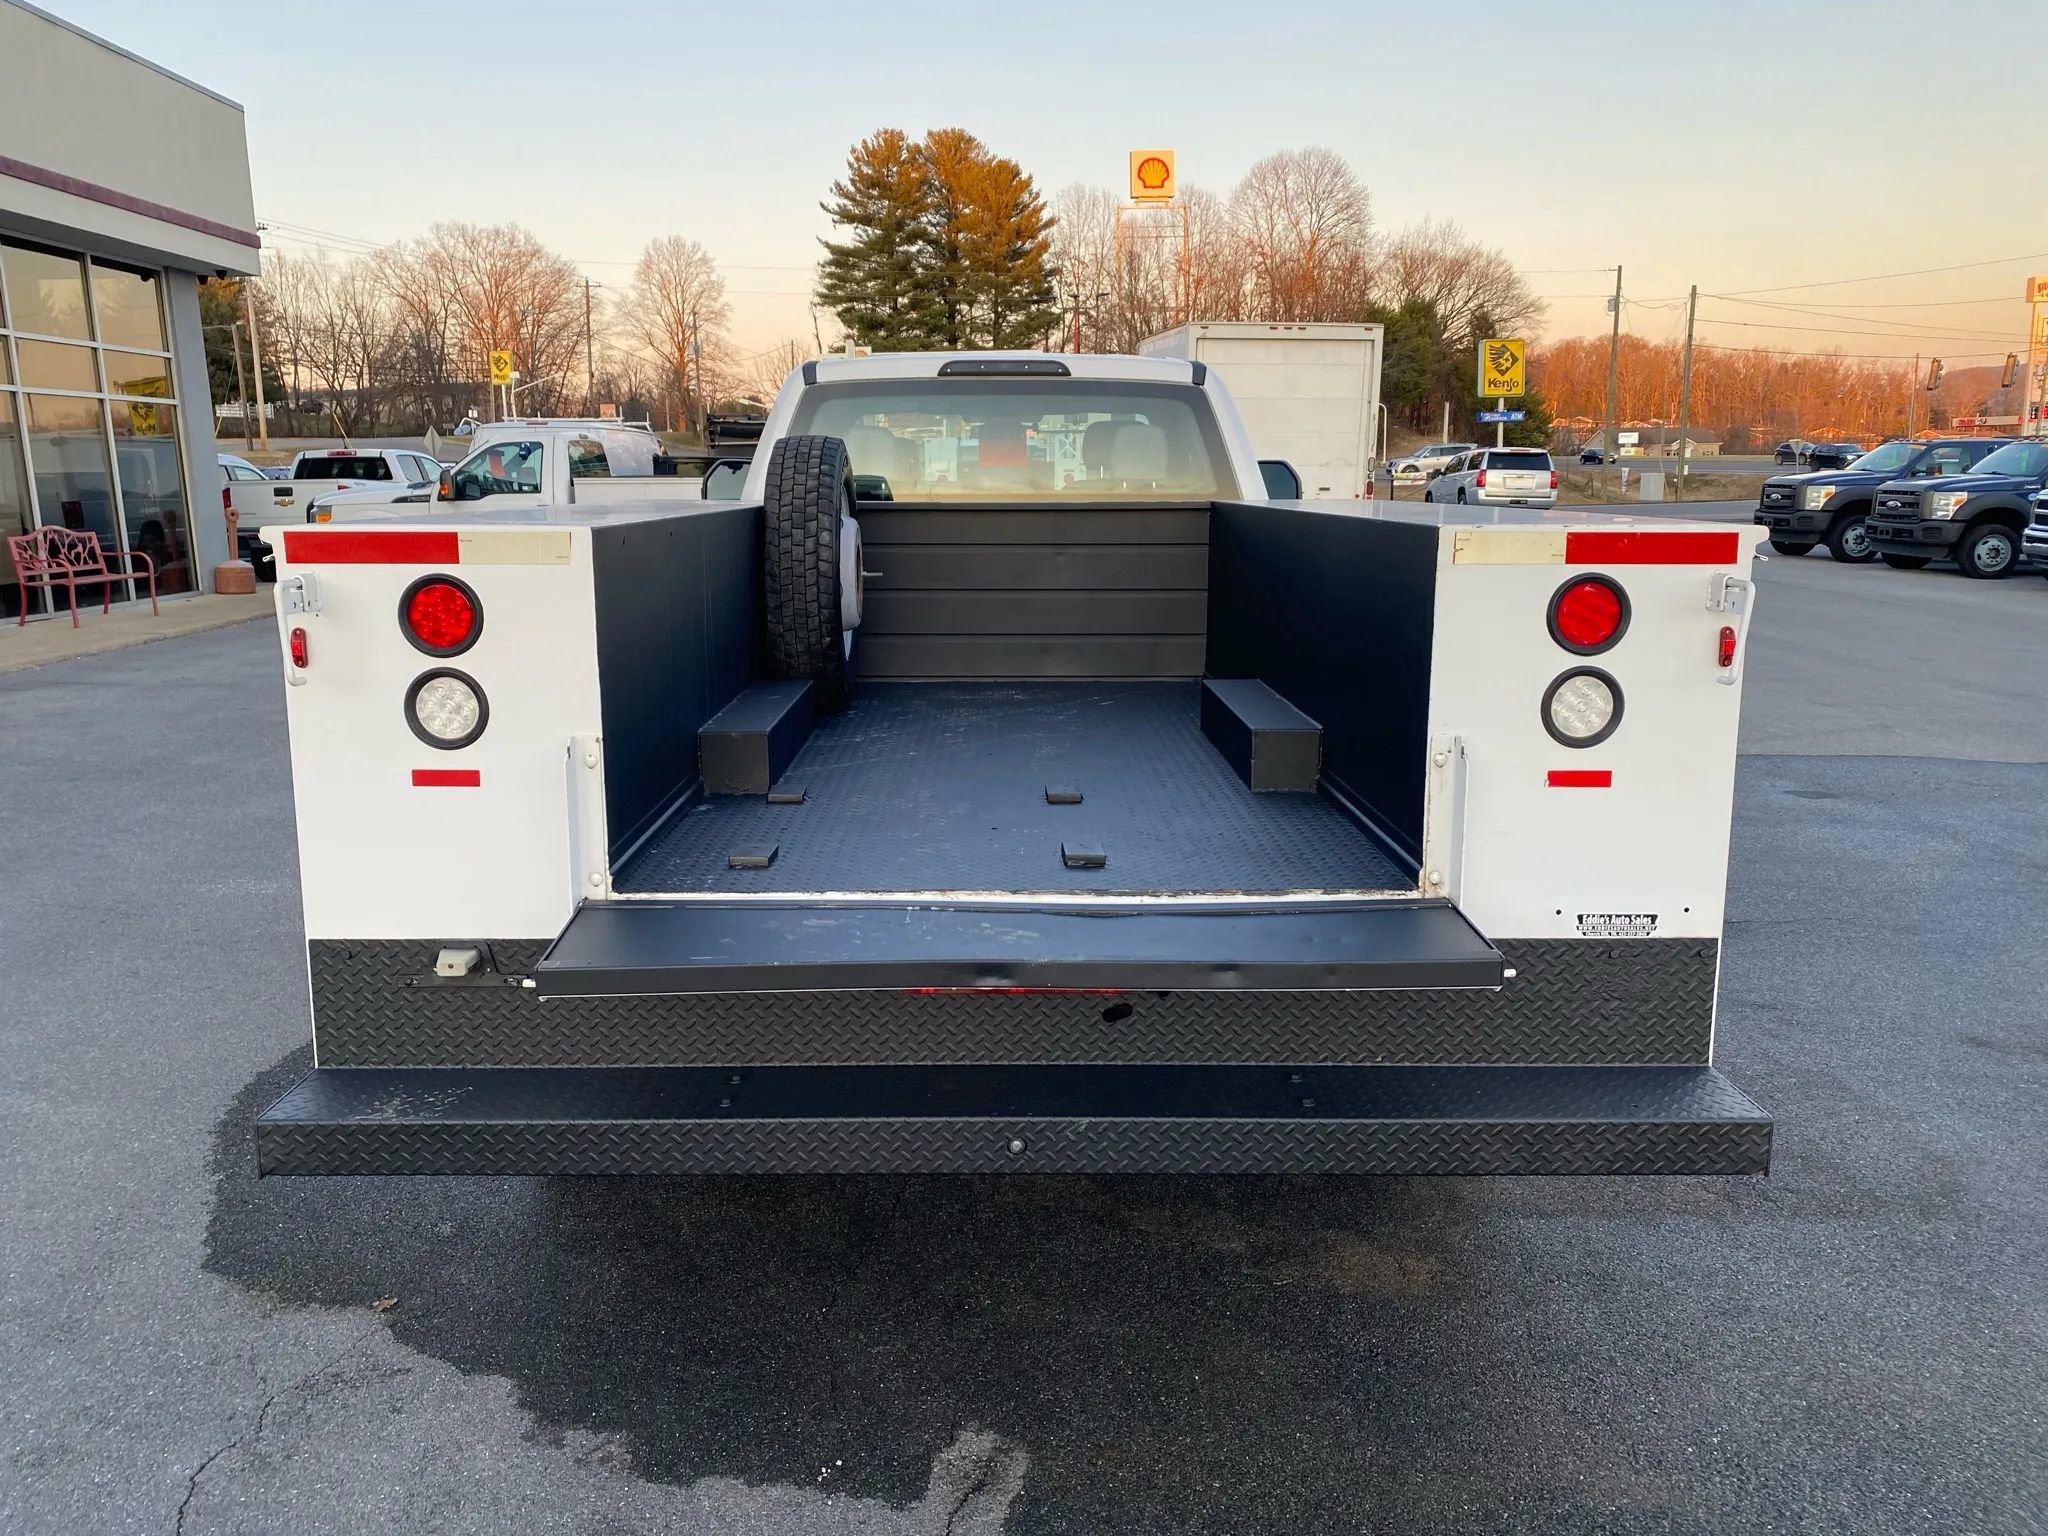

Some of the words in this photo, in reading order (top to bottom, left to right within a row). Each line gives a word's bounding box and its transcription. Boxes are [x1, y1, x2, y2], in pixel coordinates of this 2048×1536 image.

[1583, 914, 1609, 925] Eddie's
[1610, 914, 1630, 925] Auto
[1631, 914, 1652, 925] Sales
